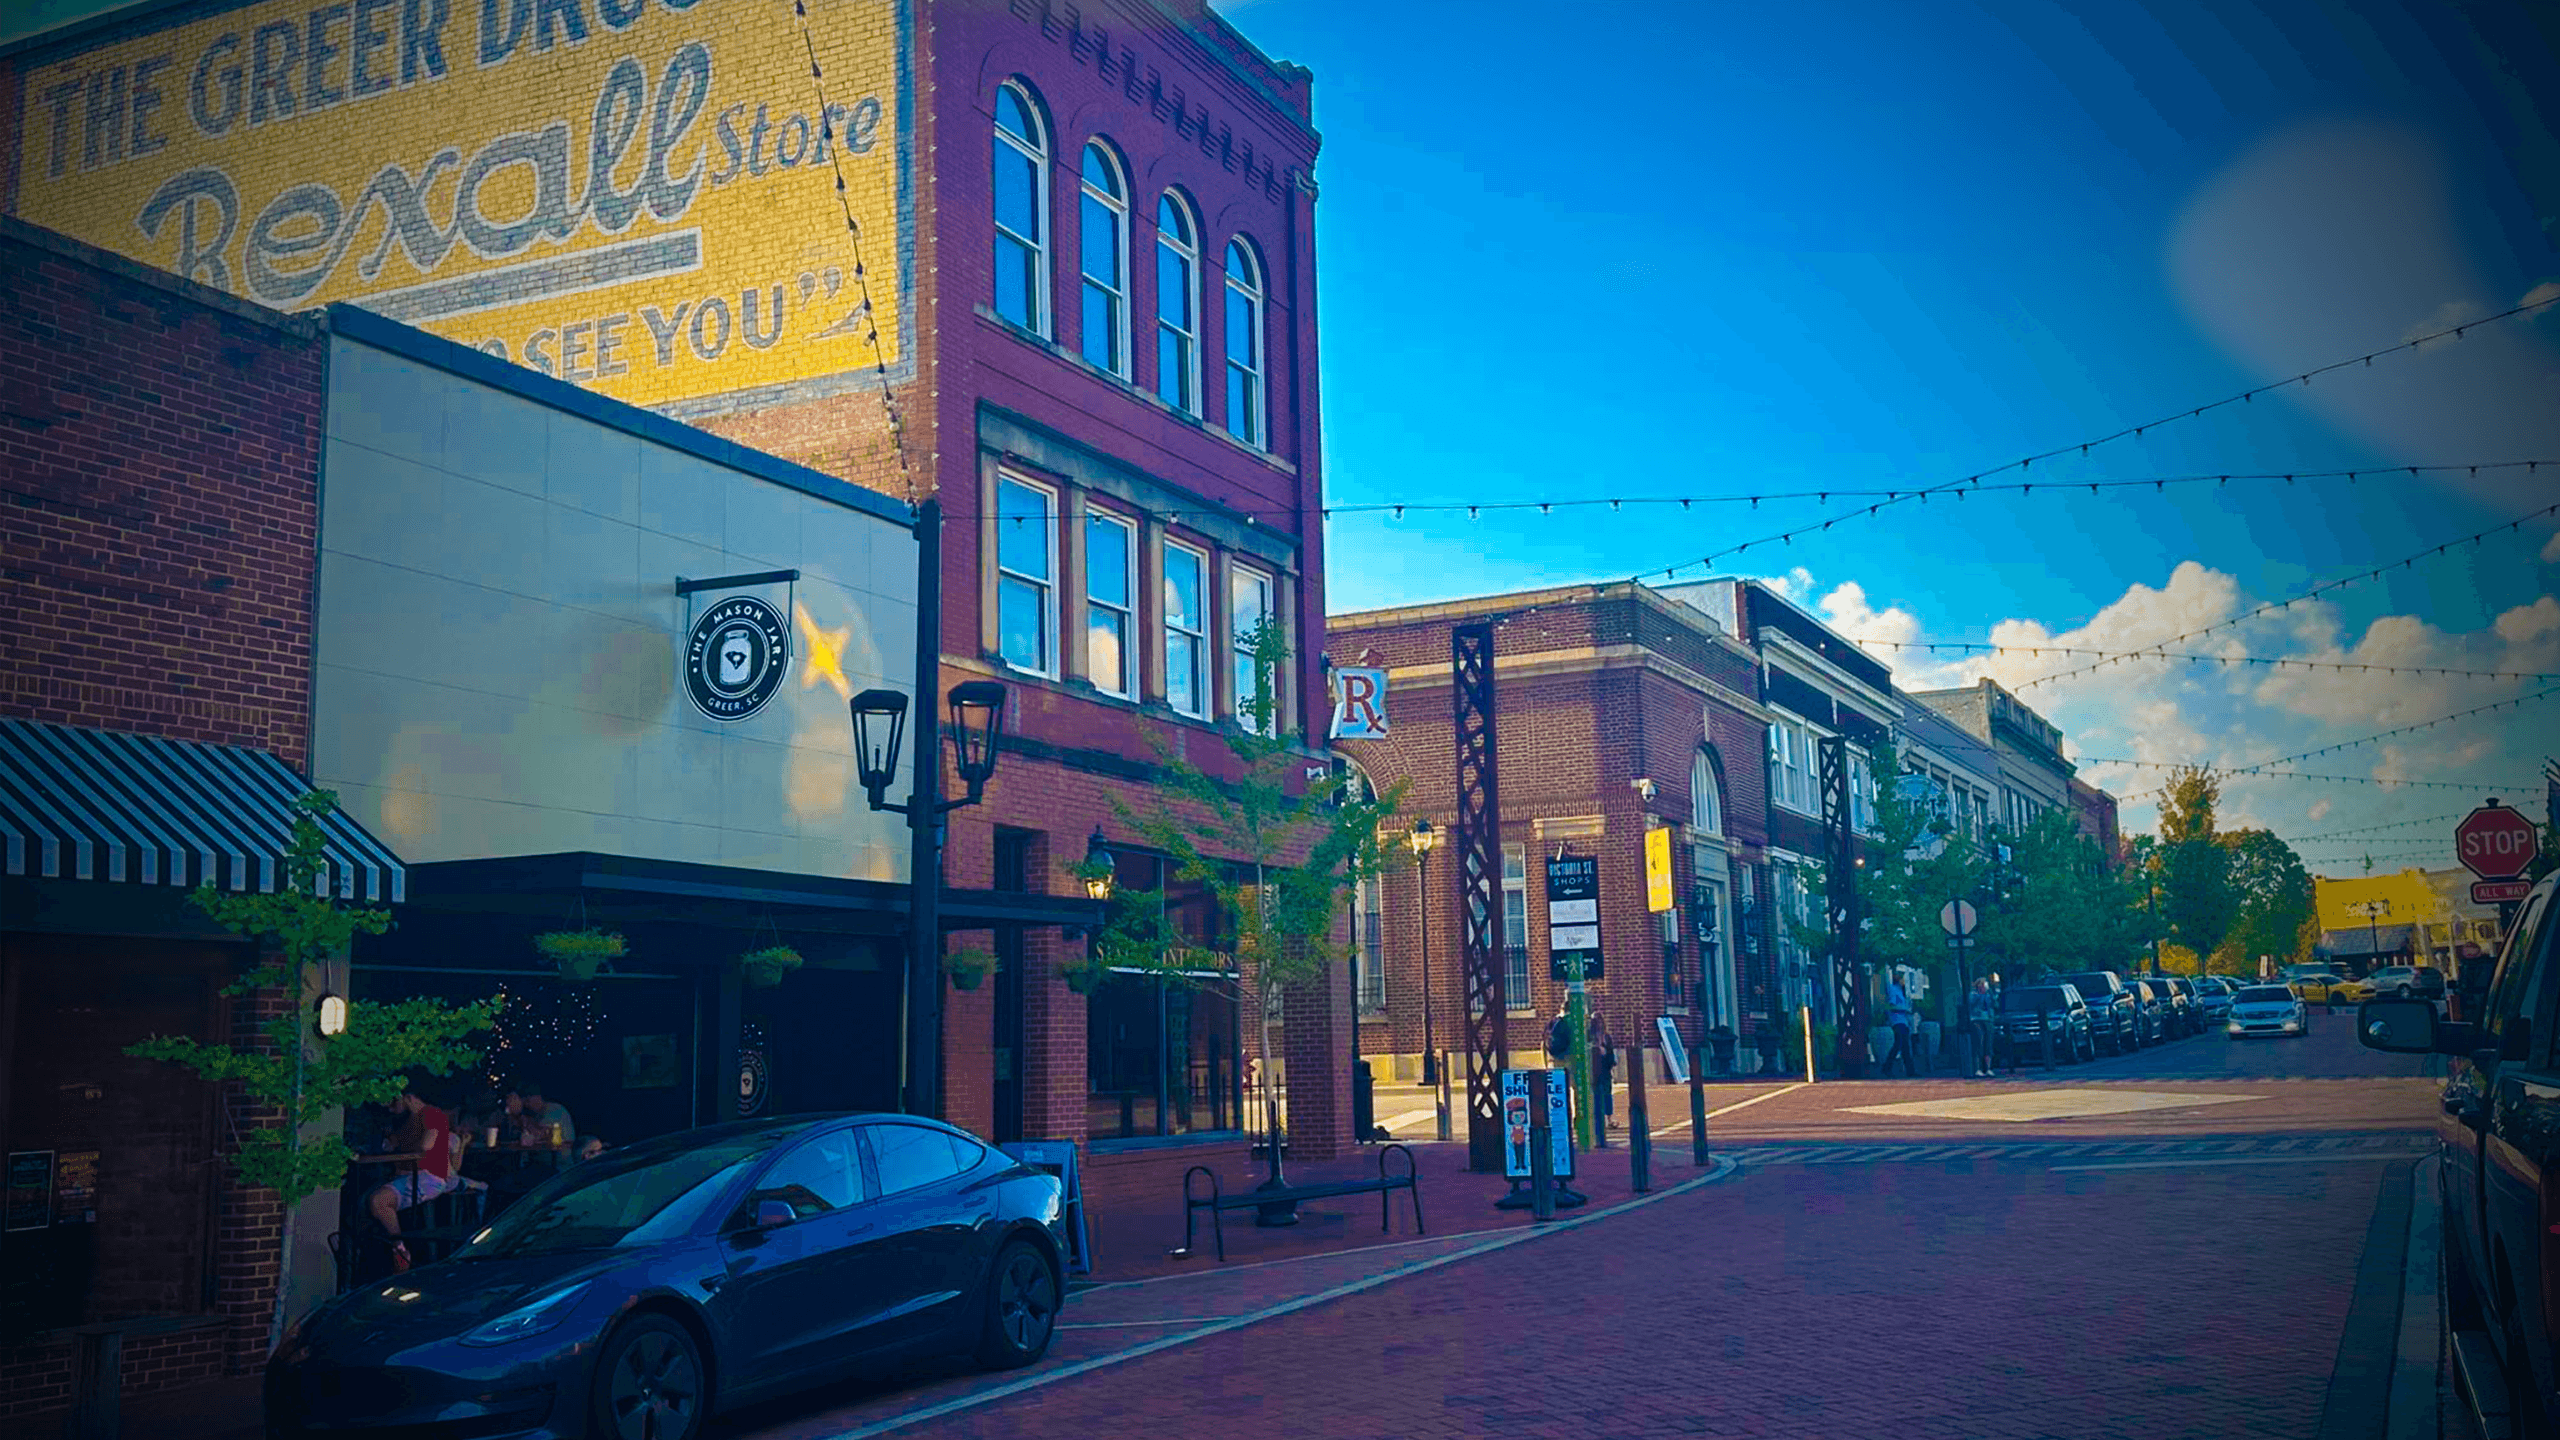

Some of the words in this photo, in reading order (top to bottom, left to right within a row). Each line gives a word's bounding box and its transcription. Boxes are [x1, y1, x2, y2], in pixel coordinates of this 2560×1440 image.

[38, 52, 172, 182] THE
[188, 0, 450, 139] GREER
[133, 39, 713, 313] Rexall
[712, 95, 882, 187] Store
[522, 312, 630, 383] SEE
[690, 630, 707, 662] THE
[713, 605, 763, 624] MASON
[766, 626, 782, 655] JAR
[746, 693, 759, 706] SC
[2465, 829, 2528, 856] STOP
[1554, 877, 1590, 886] SHOPS
[2480, 887, 2499, 898] ALL
[2505, 885, 2526, 896] WAY
[1505, 1084, 1563, 1096] SHULE
